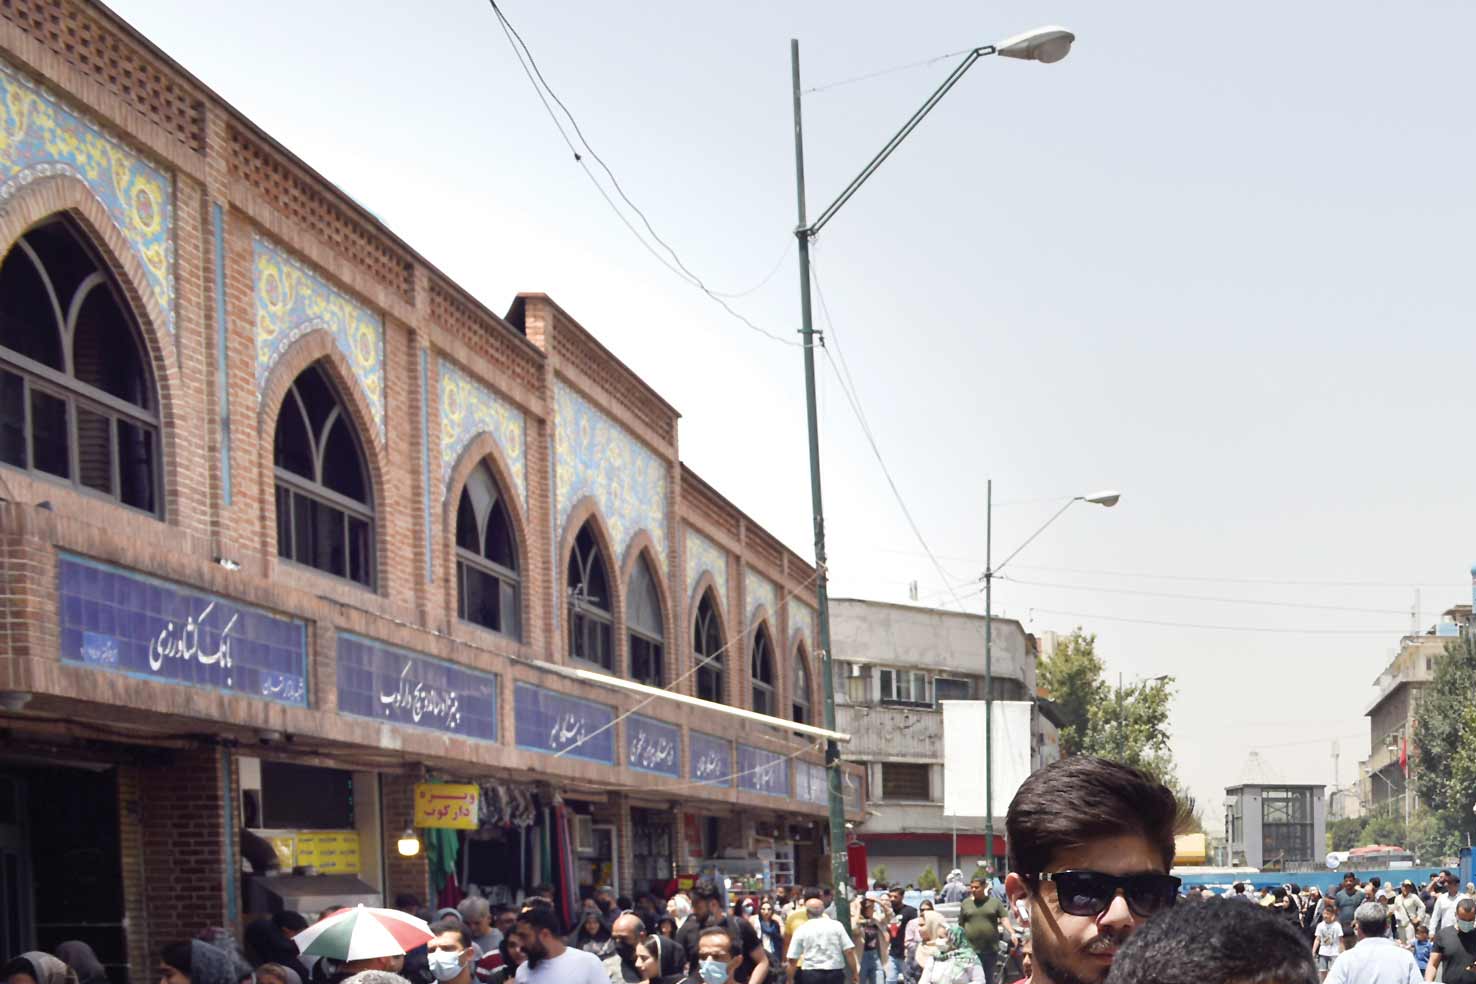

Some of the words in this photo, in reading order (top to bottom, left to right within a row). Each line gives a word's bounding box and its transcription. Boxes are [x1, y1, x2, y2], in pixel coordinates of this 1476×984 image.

[149, 600, 216, 672] کشاورزی
[197, 612, 239, 687] بانک
[380, 660, 412, 716] دارکوب
[446, 691, 461, 729] پیتزا
[419, 792, 475, 805] ویژه
